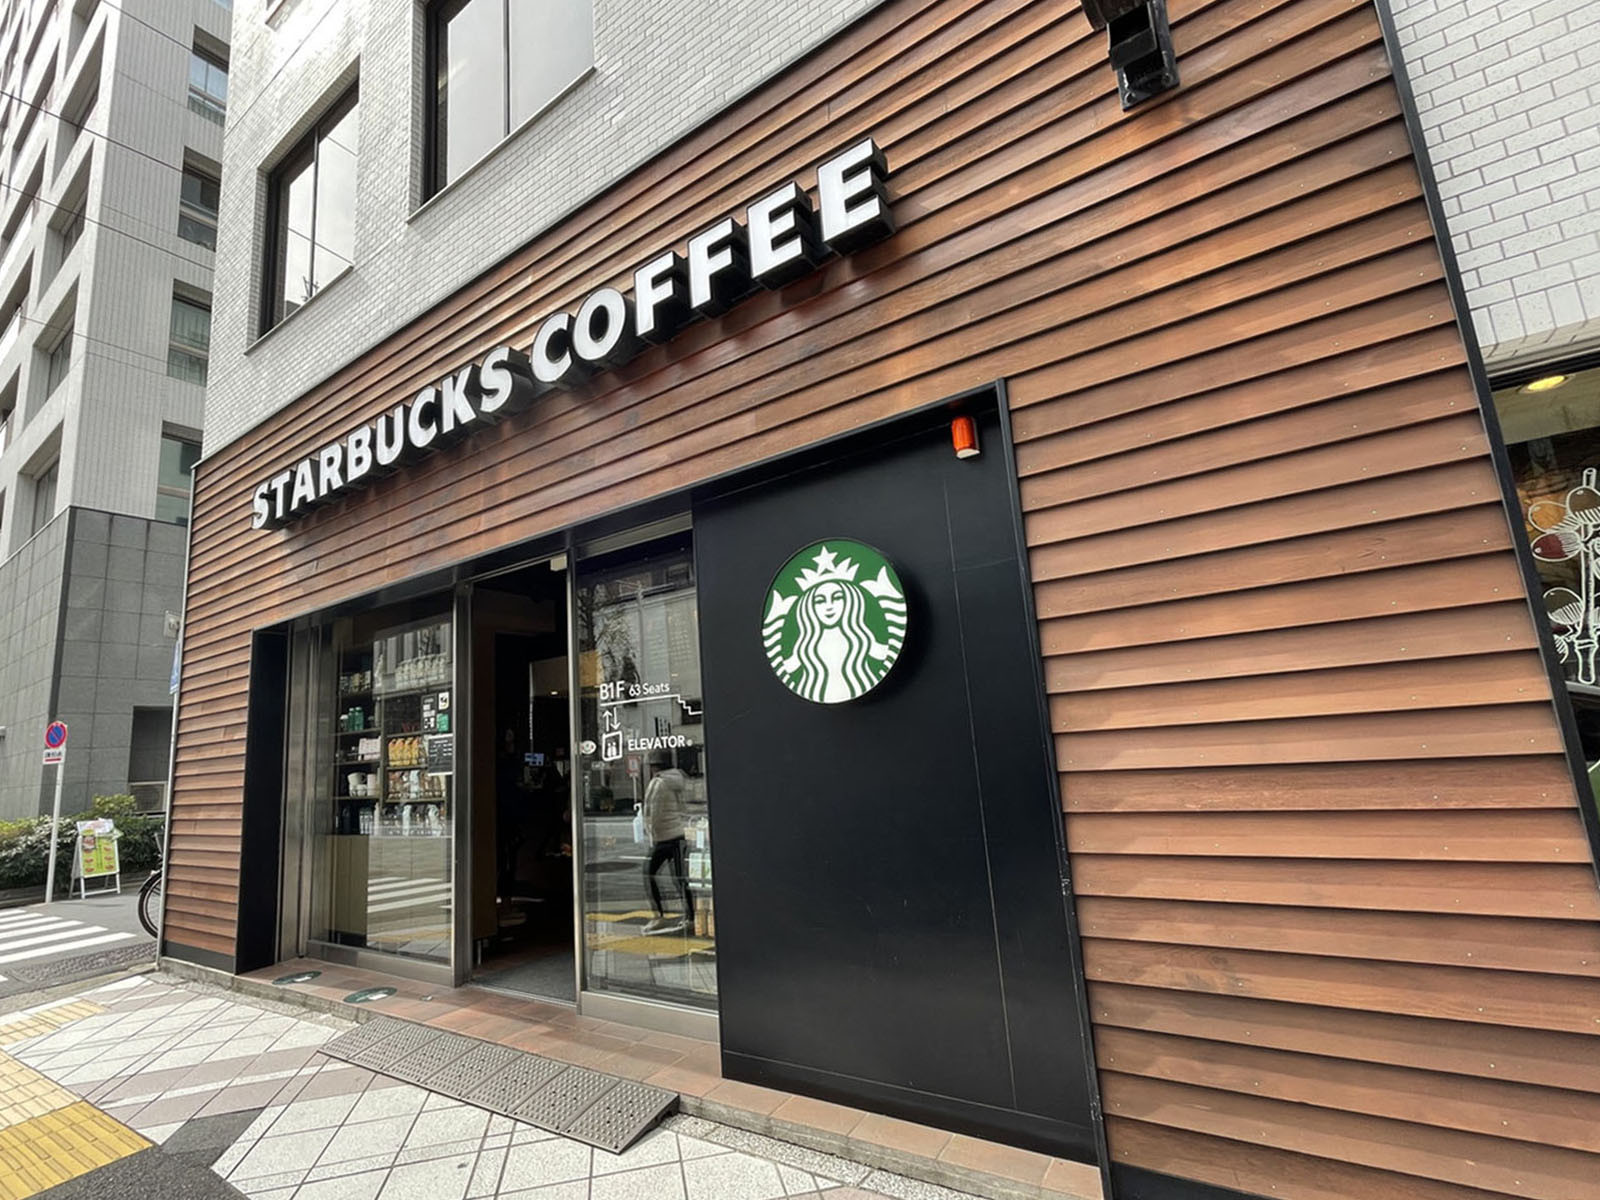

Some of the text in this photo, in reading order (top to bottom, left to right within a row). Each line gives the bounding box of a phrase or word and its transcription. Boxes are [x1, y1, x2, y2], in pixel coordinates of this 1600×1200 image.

[251, 137, 881, 530] STARBUCKS COFFEE
[599, 680, 670, 700] B1F 63 Seats
[627, 735, 686, 751] ELEVATOR
